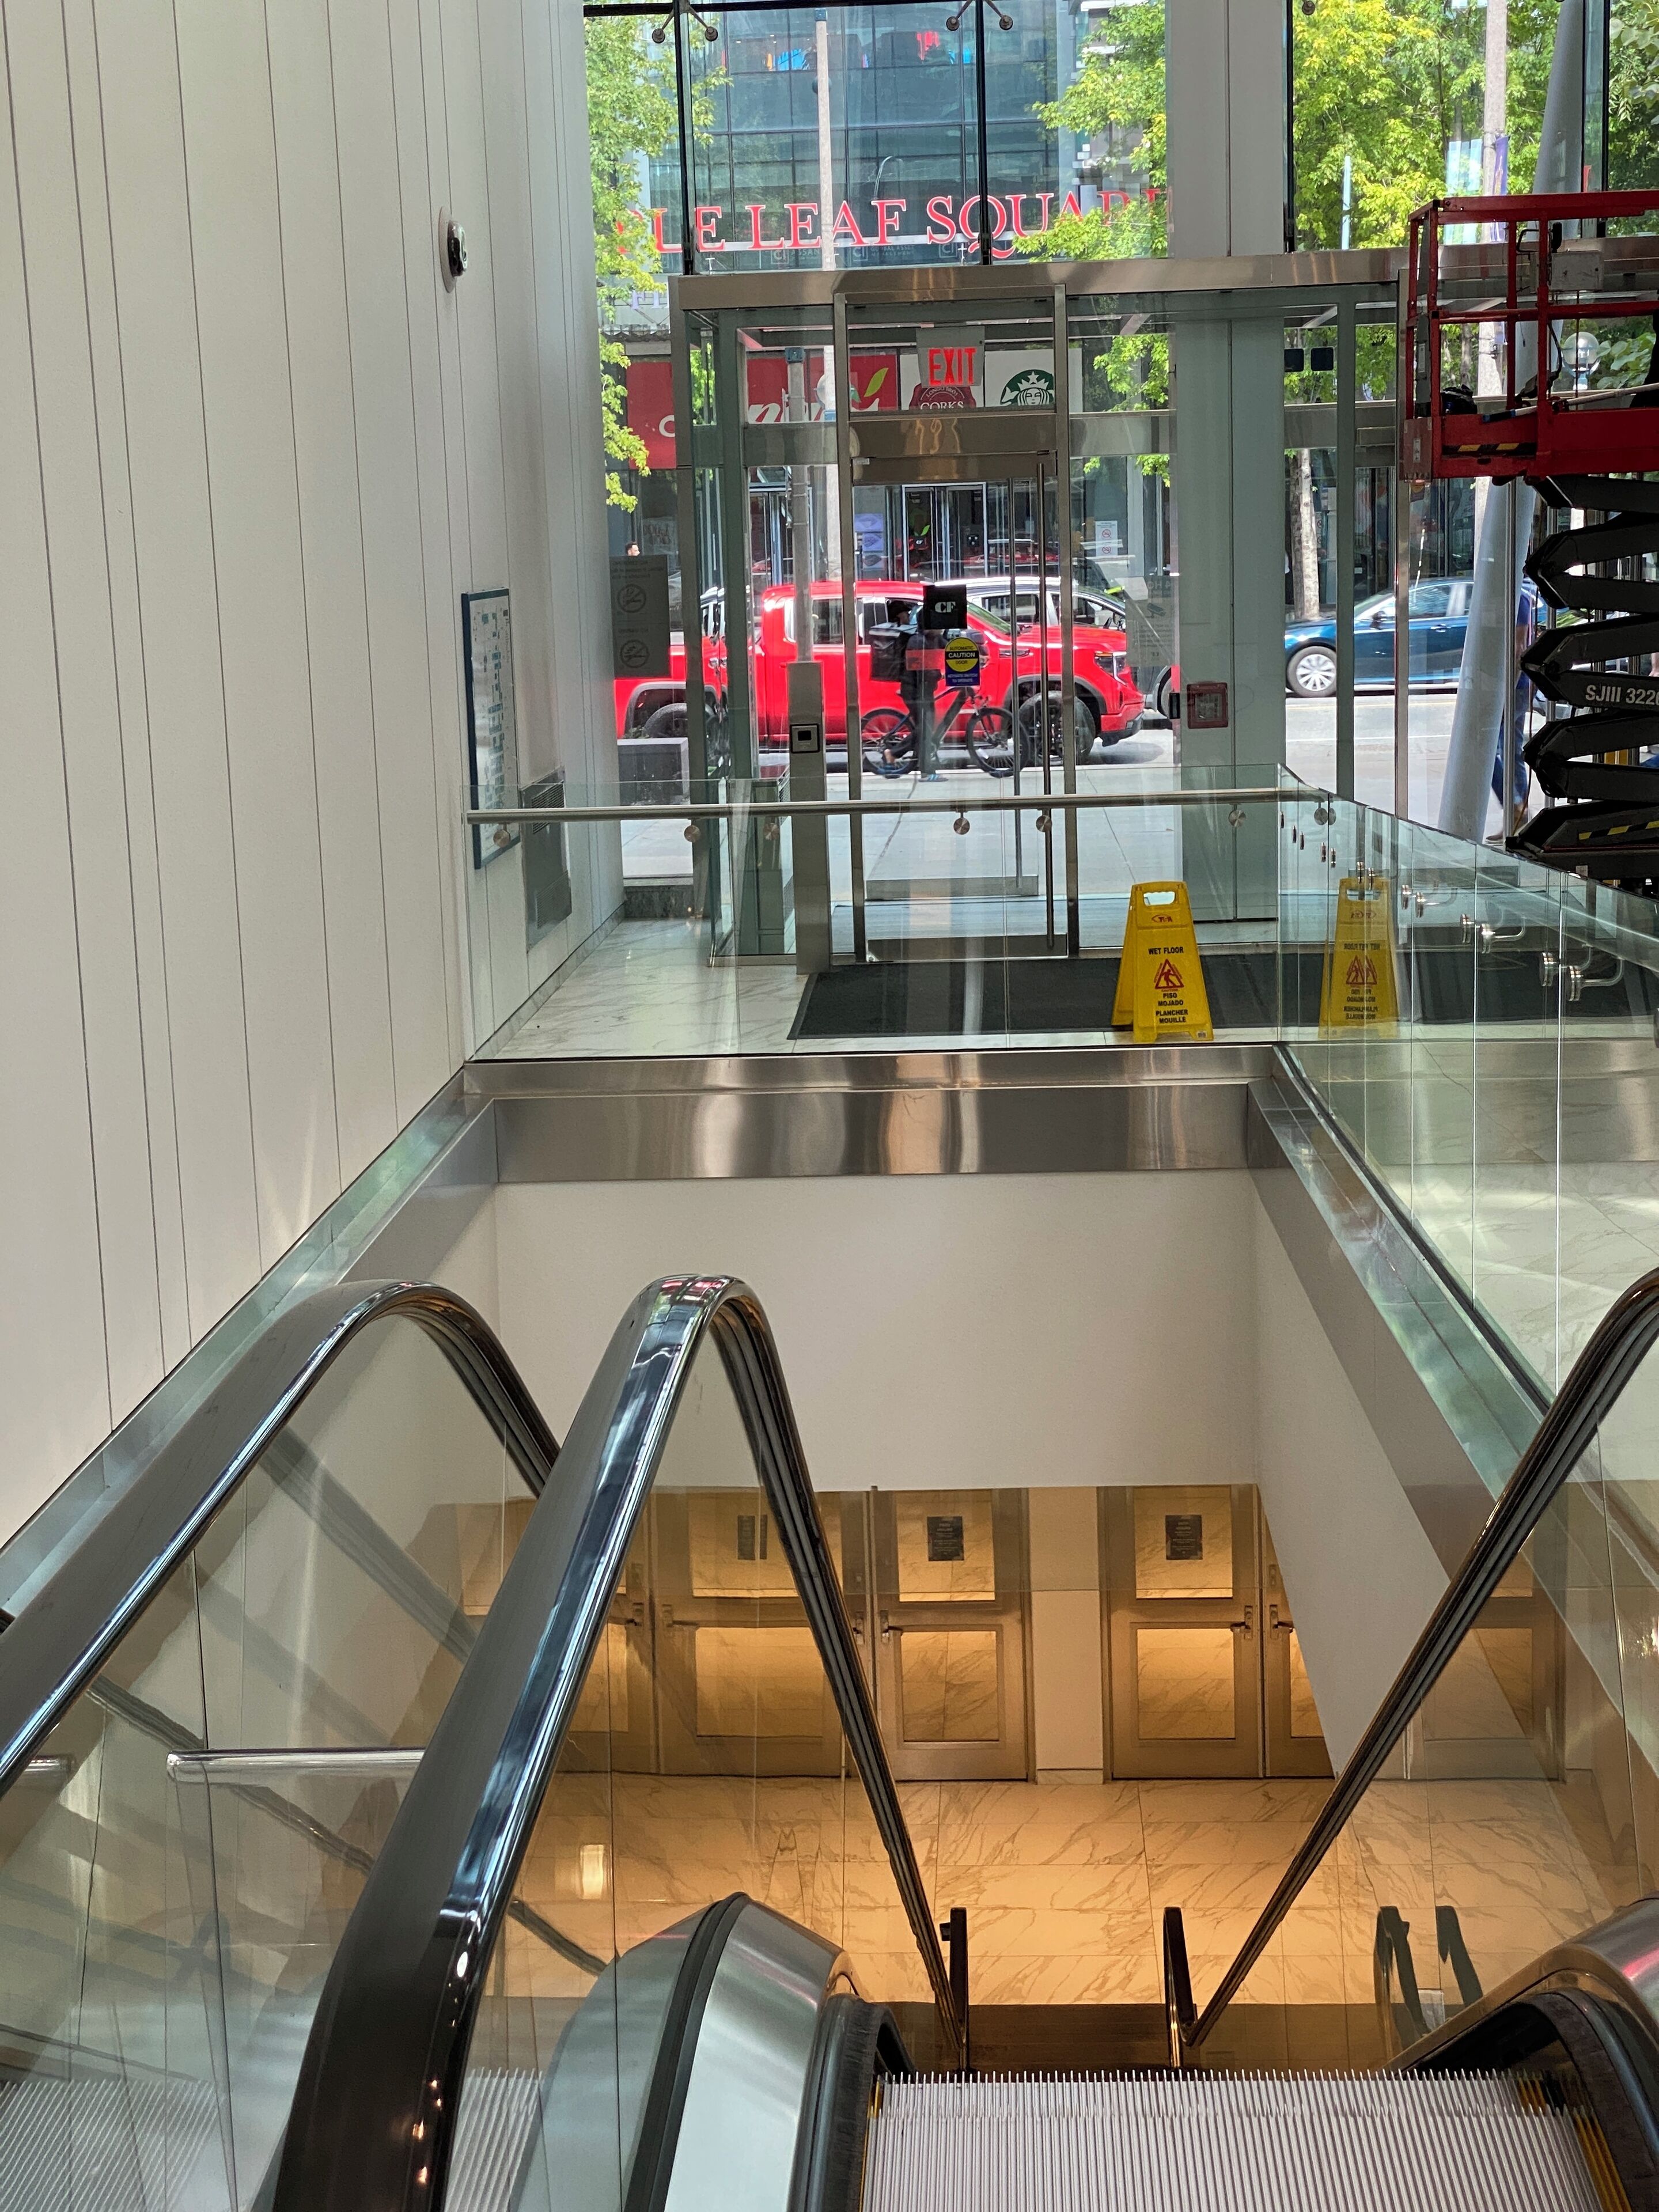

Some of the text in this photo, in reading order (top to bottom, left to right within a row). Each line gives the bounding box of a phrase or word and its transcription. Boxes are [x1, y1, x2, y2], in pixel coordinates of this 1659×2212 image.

[745, 199, 907, 250] LEAF
[929, 347, 976, 386] EXIT
[920, 400, 964, 410] CORKS
[934, 601, 956, 613] CF
